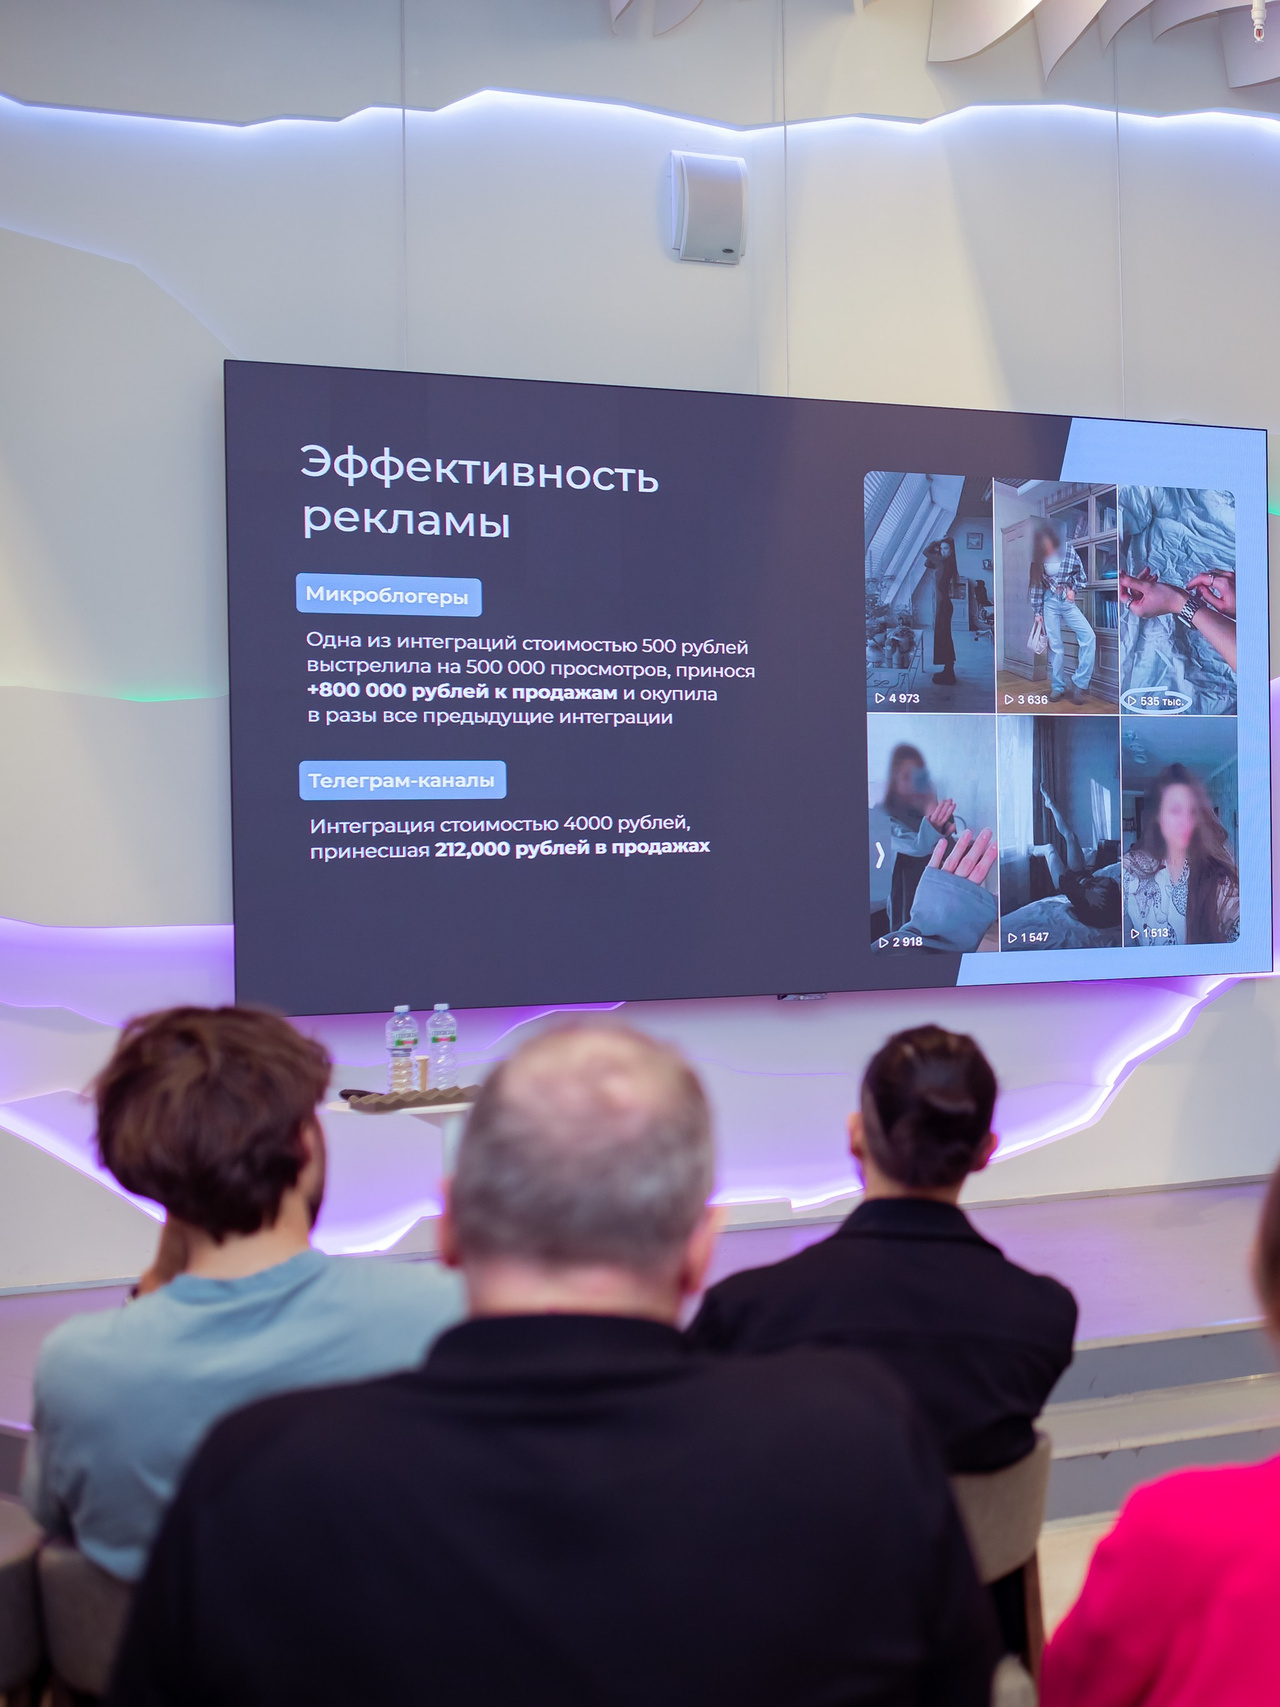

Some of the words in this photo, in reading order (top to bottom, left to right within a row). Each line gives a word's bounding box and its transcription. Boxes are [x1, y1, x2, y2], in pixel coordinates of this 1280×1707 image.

[300, 444, 659, 493] Эффективность
[304, 505, 510, 539] рекламы
[306, 585, 469, 608] Микроблогеры
[306, 631, 362, 650] Одна
[367, 635, 391, 648] из
[397, 635, 517, 653] интеграций
[522, 639, 638, 653] стоимостью
[641, 638, 677, 654] 500
[681, 638, 748, 658] рублей
[307, 659, 432, 676] выстрелила
[437, 662, 461, 674] на
[465, 659, 503, 675] 500
[507, 659, 546, 675] 000
[550, 663, 672, 680] просмотров,
[676, 665, 756, 681] принося
[307, 681, 360, 698] +800
[365, 682, 407, 698] 000
[412, 682, 489, 702] рублей
[494, 687, 508, 699] к
[512, 687, 618, 703] продажам
[623, 688, 635, 701] и
[640, 689, 718, 704] окупила
[898, 693, 920, 704] 973
[1027, 694, 1049, 705] 636
[1140, 696, 1160, 707] 535
[1161, 697, 1186, 707] тыс.
[308, 710, 320, 723] в
[326, 710, 377, 726] разы
[383, 710, 418, 723] все
[423, 711, 555, 727] предыдущие
[559, 712, 673, 728] интеграции
[307, 773, 495, 792] Телеграм-каналы
[310, 818, 435, 837] Интеграция
[440, 819, 559, 833] стоимостью
[563, 815, 613, 831] 4000
[618, 814, 691, 834] рублей,
[310, 845, 430, 862] принесшая
[434, 841, 511, 860] 212,000
[515, 839, 590, 860] рублей
[595, 842, 608, 855] в
[611, 841, 711, 858] продажах
[902, 936, 923, 947] 918
[1029, 932, 1050, 943] 547
[1150, 927, 1169, 938] 513
